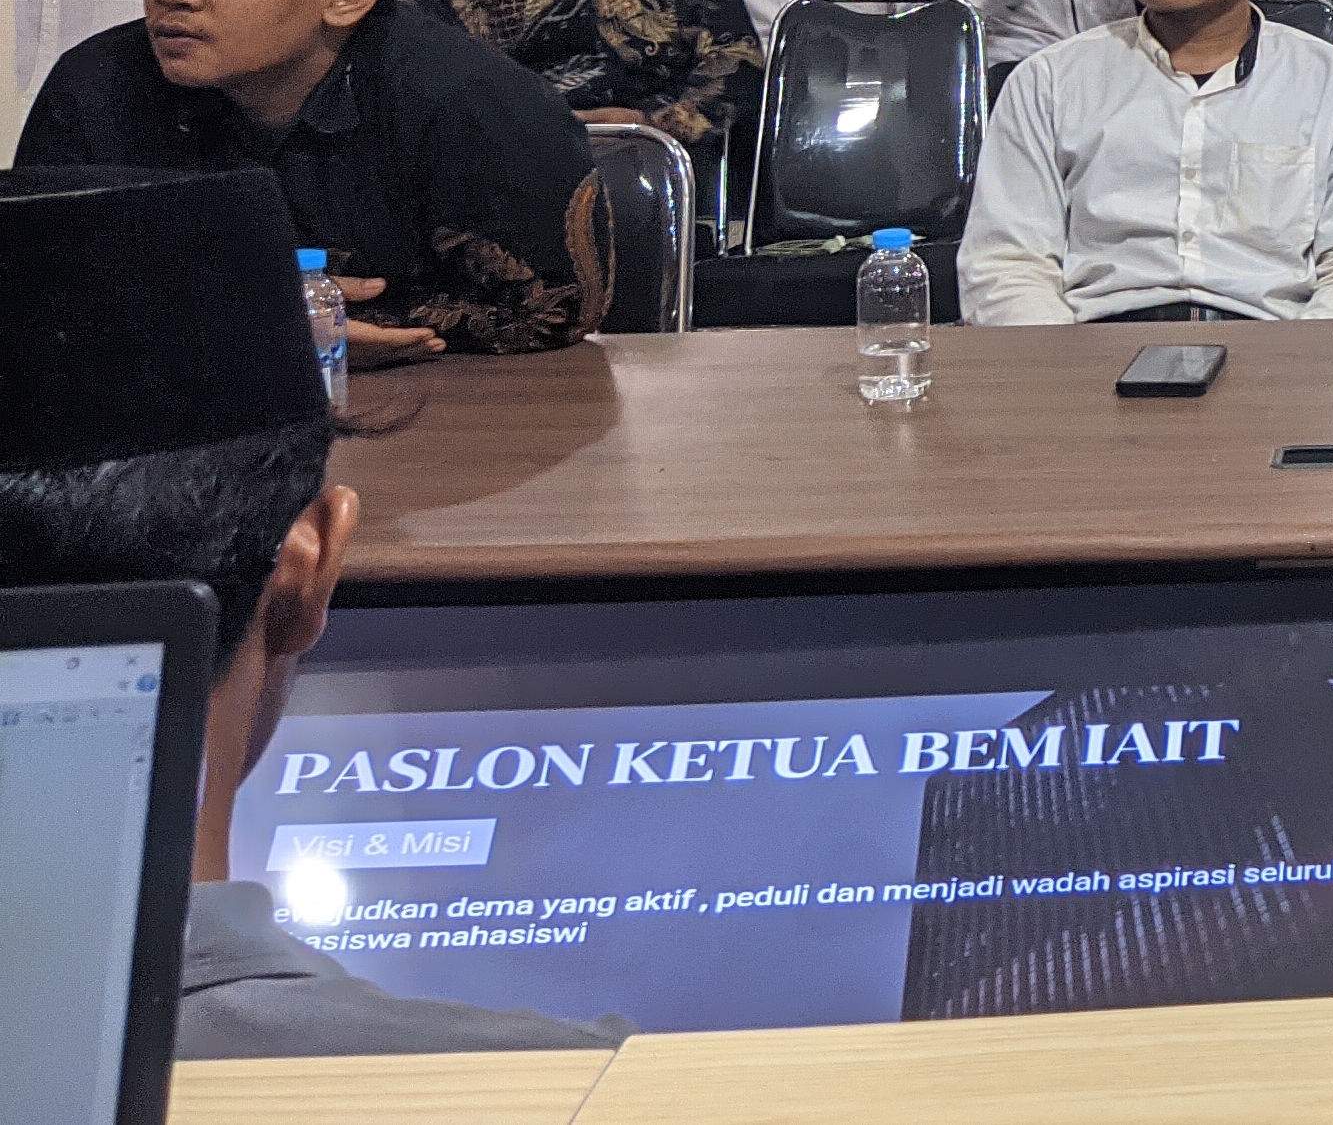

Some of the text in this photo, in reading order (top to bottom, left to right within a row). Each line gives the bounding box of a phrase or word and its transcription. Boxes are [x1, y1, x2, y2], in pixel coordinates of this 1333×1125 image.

[275, 720, 1239, 795] PASLON KETUA BEM IAIT
[293, 831, 472, 857] Visi & Misi
[447, 897, 533, 917] dema
[541, 897, 616, 923] yang
[625, 889, 696, 911] aktif
[716, 885, 809, 912] peduli
[817, 884, 874, 903] dan
[883, 876, 1003, 902] menjadi
[1012, 871, 1109, 894] wadah
[1119, 864, 1235, 892] aspirasi
[289, 917, 587, 950] asiswa mahasiswi
